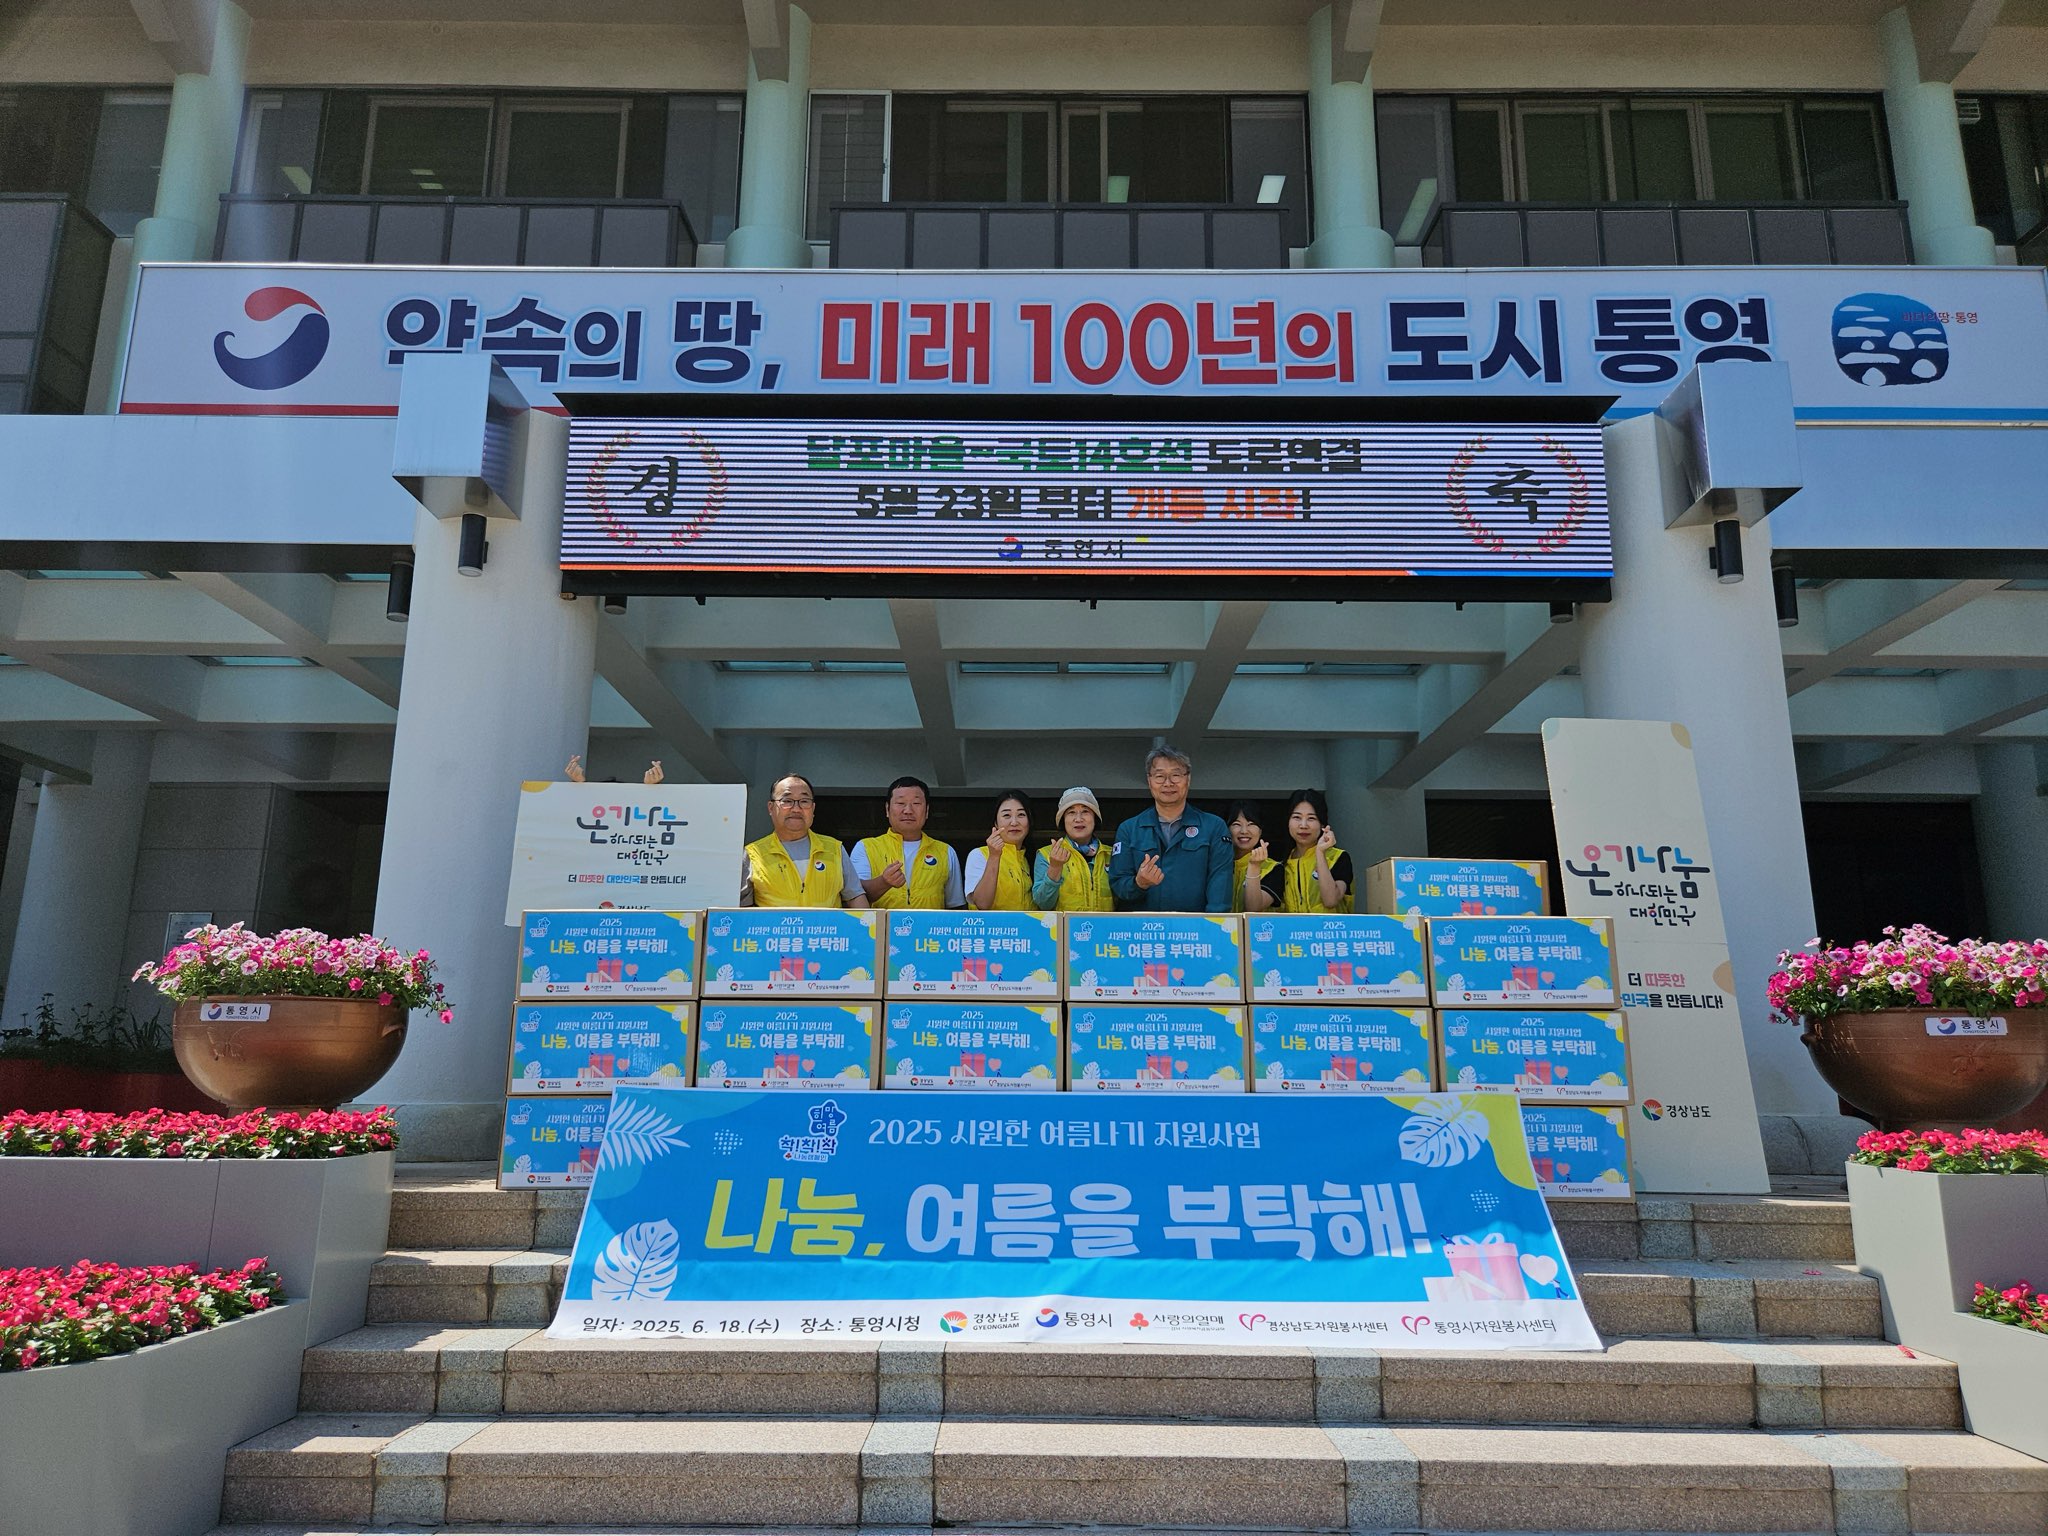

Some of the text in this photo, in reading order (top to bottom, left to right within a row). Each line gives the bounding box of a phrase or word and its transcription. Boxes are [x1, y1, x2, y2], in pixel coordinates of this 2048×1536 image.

[386, 297, 1772, 389] 약속의 땅, 미래 100년의 도시 통영
[1207, 438, 1361, 473] 도로연결
[625, 456, 678, 516] 경
[1486, 462, 1549, 524] 축
[856, 485, 918, 519] 5월
[934, 486, 1021, 519] 23일
[1036, 486, 1111, 520] 부터
[577, 805, 688, 845] 온기나눔
[610, 833, 658, 849] 하나되는
[617, 849, 669, 865] 대한민국
[568, 874, 687, 884] 더 따뜻한 대한민국을 만듭니다!
[1566, 844, 1710, 899] 온기나눔
[1615, 880, 1678, 903] 하나되는
[600, 918, 622, 926] 2025
[781, 917, 803, 925] 2025
[1629, 902, 1697, 927] 대한민국
[1323, 921, 1345, 929] 2025
[1507, 925, 1530, 933] 2025
[583, 939, 622, 954] 여름을
[625, 938, 668, 954] 부탁해!
[766, 937, 804, 952] 여름을
[807, 937, 849, 952] 부탁해!
[948, 938, 985, 953] 여름을
[989, 938, 1030, 953] 부탁해!
[1128, 943, 1166, 958] 여름을
[1170, 943, 1212, 958] 부탁해!
[1310, 942, 1349, 957] 여름을
[1352, 941, 1395, 956] 부탁해!
[1494, 946, 1534, 962] 여름을
[1537, 945, 1582, 961] 부탁해!
[1628, 972, 1686, 987] 더 따뜻한
[1666, 993, 1723, 1009] 만듭니다!
[226, 1006, 261, 1015] 통영시
[591, 1012, 614, 1020] 2025
[776, 1012, 798, 1020] 2025
[962, 1011, 983, 1019] 2025
[1329, 1014, 1351, 1022] 2025
[1521, 1018, 1544, 1026] 2025
[1961, 1020, 1999, 1029] 통영시
[575, 1033, 614, 1049] 여름을
[617, 1032, 660, 1048] 부탁해!
[760, 1033, 798, 1049] 여름을
[802, 1033, 844, 1049] 부탁해!
[946, 1032, 984, 1048] 여름을
[988, 1033, 1030, 1048] 부탁해!
[1131, 1035, 1170, 1050] 여름을
[1173, 1035, 1216, 1050] 부탁해!
[1314, 1035, 1354, 1051] 여름을
[1357, 1036, 1401, 1052] 부탁해!
[1506, 1039, 1548, 1055] 여름을
[1551, 1040, 1596, 1055] 부탁해!
[1666, 1104, 1711, 1119] 경상남도
[565, 1126, 605, 1142] 여름을
[868, 1119, 1261, 1149] 2025 시원한 여름나기 지원사업
[1553, 1136, 1598, 1152] 부탁해!
[906, 1183, 1140, 1260] 여름을
[1162, 1180, 1432, 1261] 부탁해!
[583, 1317, 623, 1333] 일자:
[631, 1320, 684, 1333] 2025.
[692, 1320, 708, 1333] 6.
[800, 1317, 842, 1333] 장소:
[849, 1316, 920, 1332] 통영시청
[973, 1311, 1020, 1324] 경상남도
[1064, 1312, 1112, 1328] 통영시
[1153, 1314, 1224, 1327] 사랑의열매
[973, 1323, 1020, 1331] GYEONGNAM
[1266, 1320, 1388, 1333] 경상남도자원봉사센터
[1433, 1319, 1557, 1334] 통영시자원봉사센터
